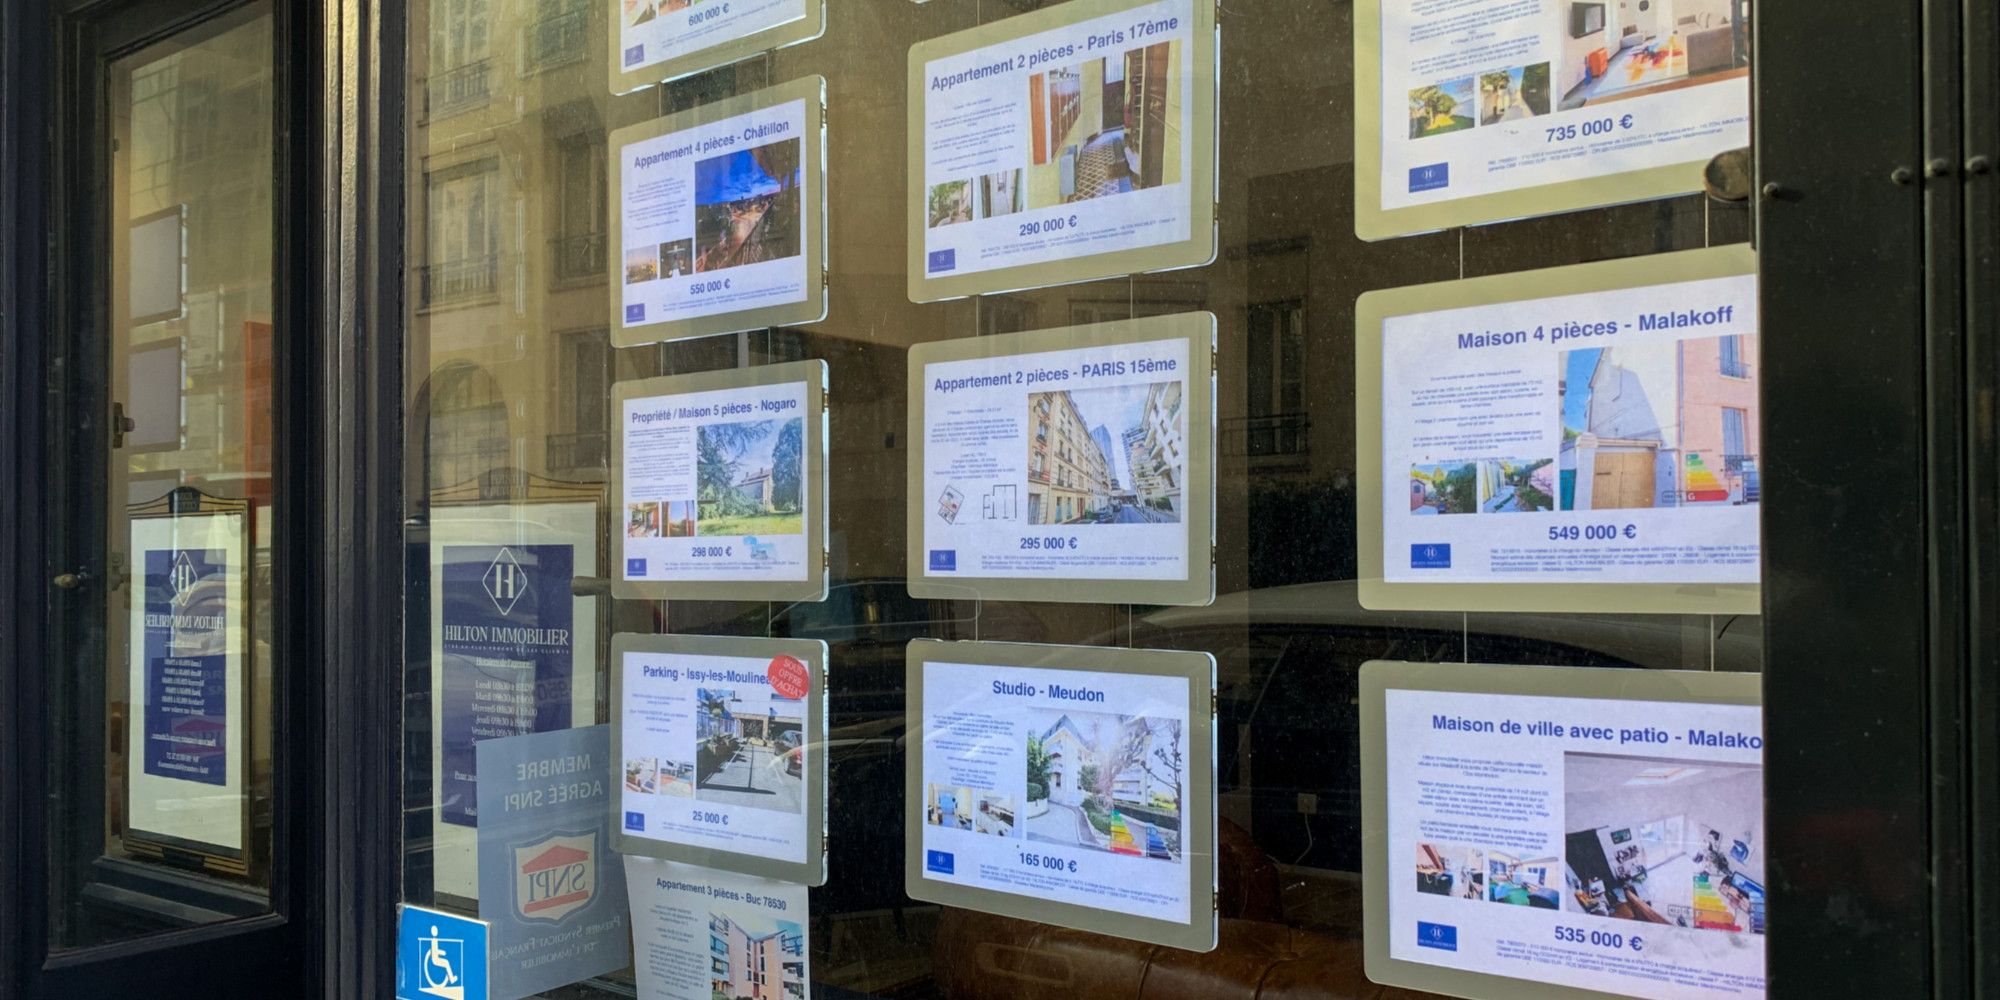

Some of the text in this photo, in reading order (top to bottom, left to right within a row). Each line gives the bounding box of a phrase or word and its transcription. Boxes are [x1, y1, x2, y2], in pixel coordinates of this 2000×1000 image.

[688, 12, 704, 26] 600
[704, 8, 720, 23] 000
[722, 3, 730, 15] €
[931, 58, 1014, 92] Appartement
[1017, 55, 1025, 69] 2
[1029, 44, 1074, 69] pièces
[1087, 30, 1124, 51] Paris
[1128, 16, 1178, 40] 17ème
[1546, 113, 1633, 143] 735 000 €
[634, 144, 692, 168] Appartement
[695, 138, 701, 152] 4
[703, 132, 735, 153] pièces
[744, 120, 789, 141] Châtillon
[1019, 222, 1040, 237] 290
[1043, 219, 1065, 233] 000
[1068, 215, 1077, 228] €
[690, 278, 731, 295] 550 000 €
[1457, 329, 1527, 350] Maison
[1533, 326, 1544, 342] 4
[1550, 318, 1617, 345] pièces
[1639, 305, 1733, 331] Malakoff
[934, 374, 1012, 393] Appartement
[1015, 372, 1023, 384] 2
[1026, 367, 1069, 387] pièces
[1082, 361, 1125, 378] PARIS
[1130, 358, 1177, 374] 15ème
[632, 409, 671, 423] Propriété
[673, 409, 677, 419] /
[678, 406, 711, 419] Maison
[713, 405, 719, 416] 5
[721, 402, 752, 417] pièces
[760, 398, 797, 413] Nogaro
[1020, 537, 1078, 550] 295 000 €
[1549, 524, 1637, 541] 549 000 €
[691, 546, 732, 558] 298 000 €
[495, 564, 514, 599] H
[445, 625, 569, 646] HILTON IMMOBILIER
[643, 665, 679, 681] Parking
[992, 680, 1036, 697] Studio
[1048, 684, 1105, 702] Meudon
[1432, 714, 1494, 734] Maison
[1500, 718, 1522, 735] de
[1527, 720, 1564, 737] ville
[1570, 726, 1614, 740] avec
[1620, 727, 1669, 747] patio
[1688, 729, 1762, 750] Malako
[692, 811, 729, 825] 25 000 €
[1019, 852, 1077, 873] 165 000 €
[656, 877, 705, 894] Appartement
[707, 886, 712, 896] 3
[714, 887, 739, 901] pièces
[746, 893, 761, 906] Buc
[763, 896, 786, 911] 78530
[1554, 925, 1643, 952] 535 000 €
